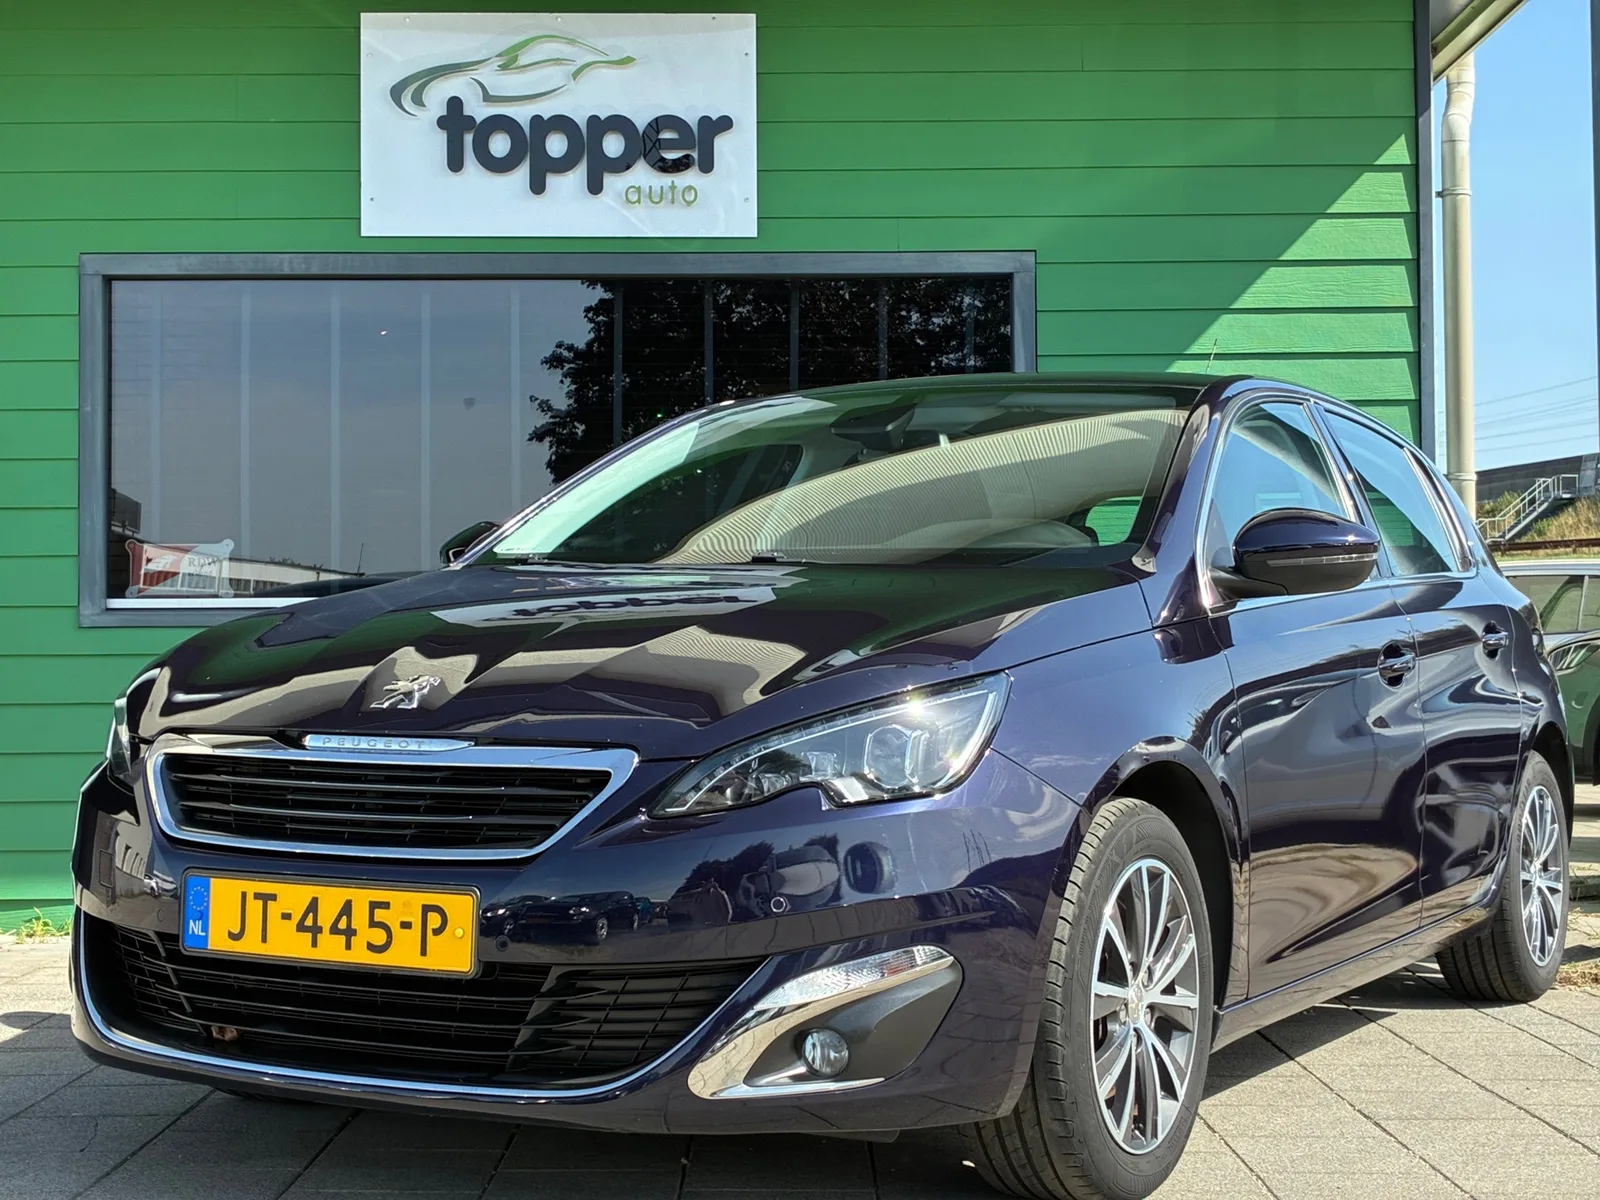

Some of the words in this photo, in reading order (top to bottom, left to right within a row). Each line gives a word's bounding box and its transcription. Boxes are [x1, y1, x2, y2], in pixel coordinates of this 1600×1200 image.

[436, 95, 734, 195] topper
[625, 180, 698, 206] auto
[322, 737, 426, 749] PEUGEOT
[188, 919, 206, 936] NL
[227, 890, 448, 957] JT-445-P
